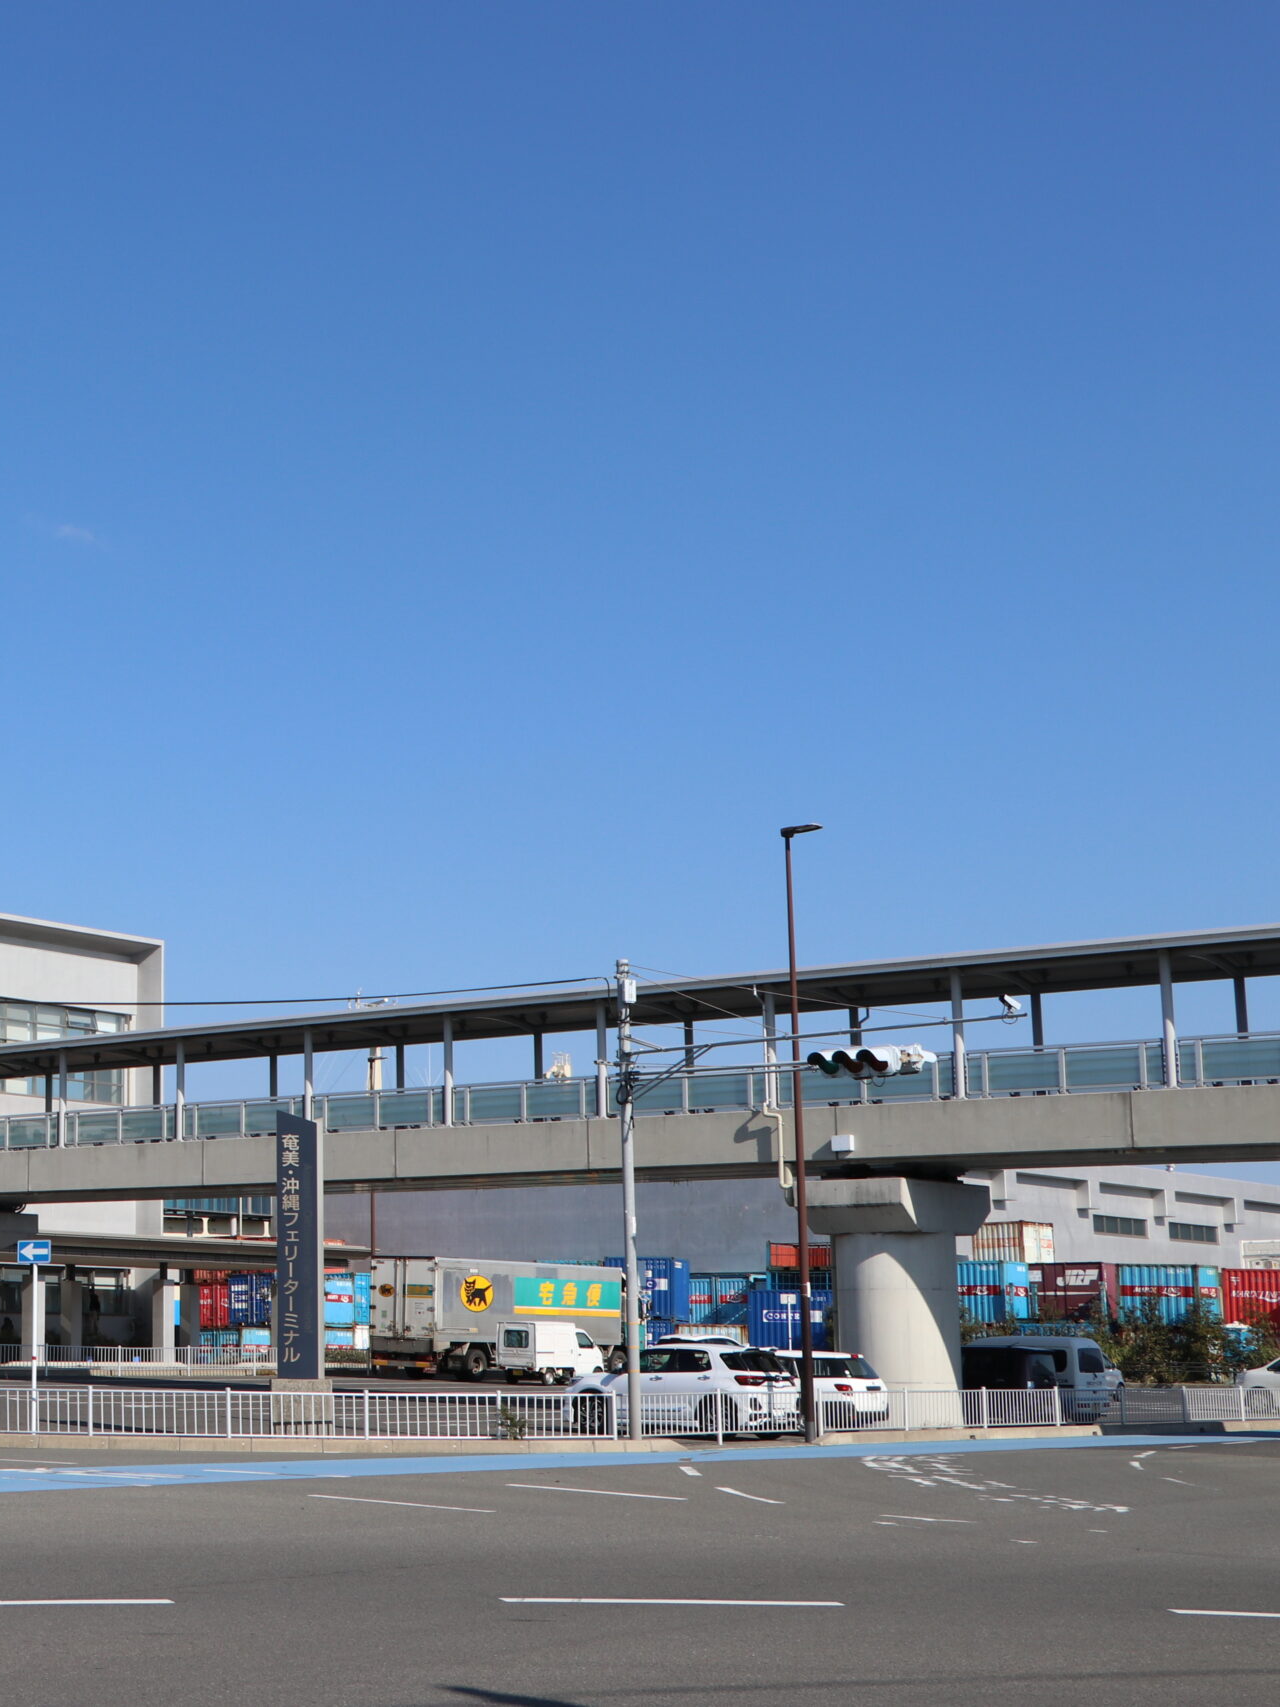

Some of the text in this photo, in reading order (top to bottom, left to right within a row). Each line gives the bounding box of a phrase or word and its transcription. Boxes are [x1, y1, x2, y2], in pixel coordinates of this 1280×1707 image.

[281, 1133, 300, 1363] 奄美・沖縄フェリーターミナル
[1056, 1269, 1099, 1286] JRF
[538, 1281, 602, 1307] 宅急便
